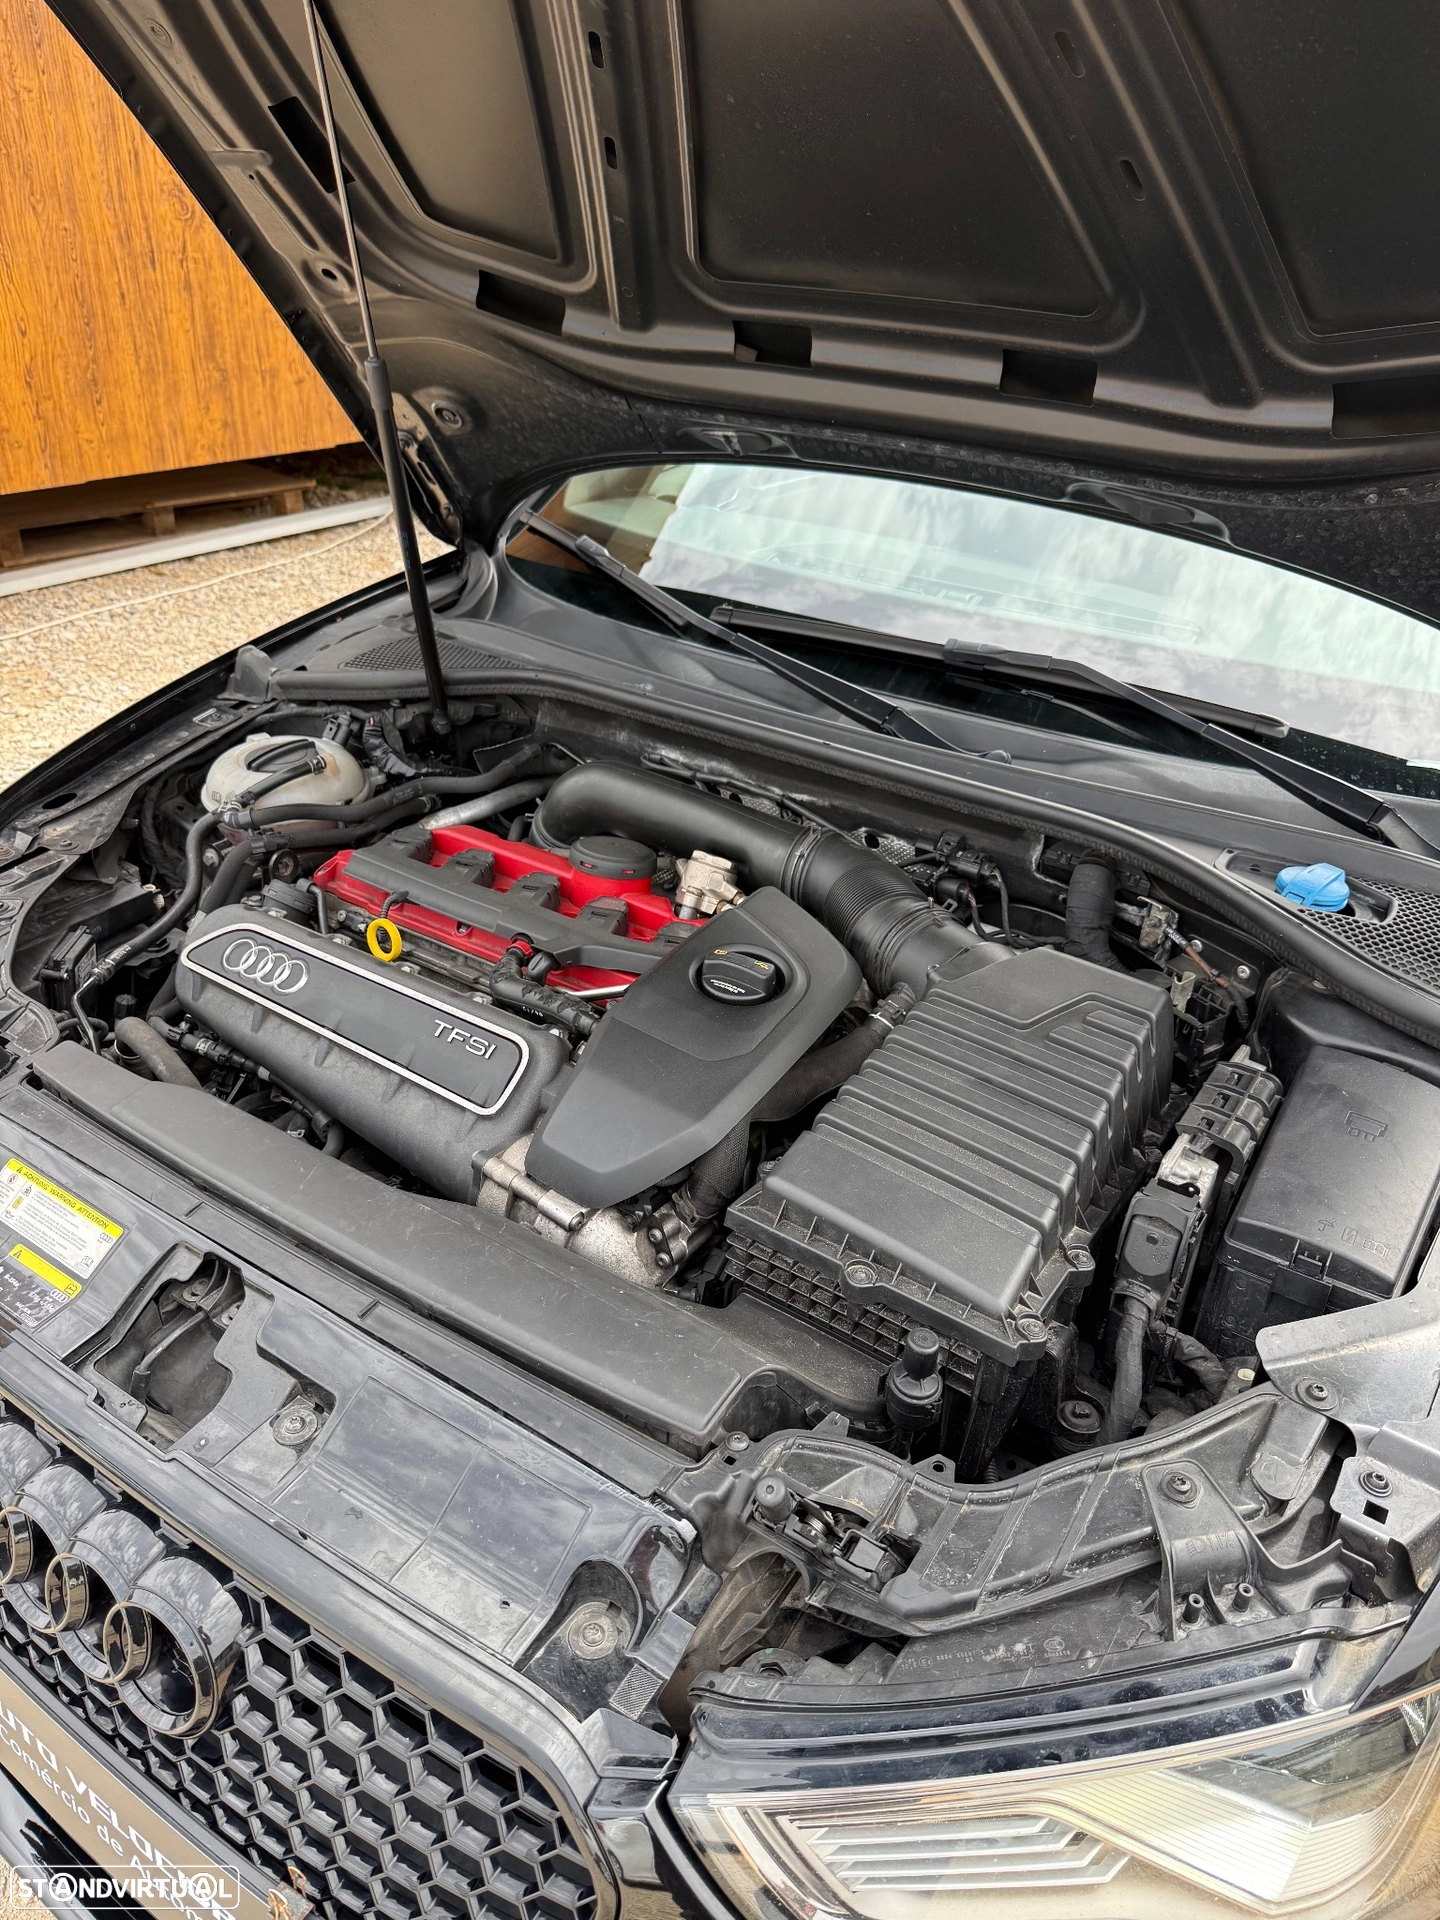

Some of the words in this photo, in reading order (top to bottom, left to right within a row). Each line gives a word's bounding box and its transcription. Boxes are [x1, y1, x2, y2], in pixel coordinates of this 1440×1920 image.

[434, 1019, 497, 1060] TFSI
[23, 1167, 50, 1191] ACHTUNG
[50, 1185, 77, 1209] WARNING
[77, 1202, 109, 1230] ATTENTION
[0, 1701, 59, 1773] UTO
[0, 1724, 91, 1824] Comércio
[97, 1824, 124, 1857] de
